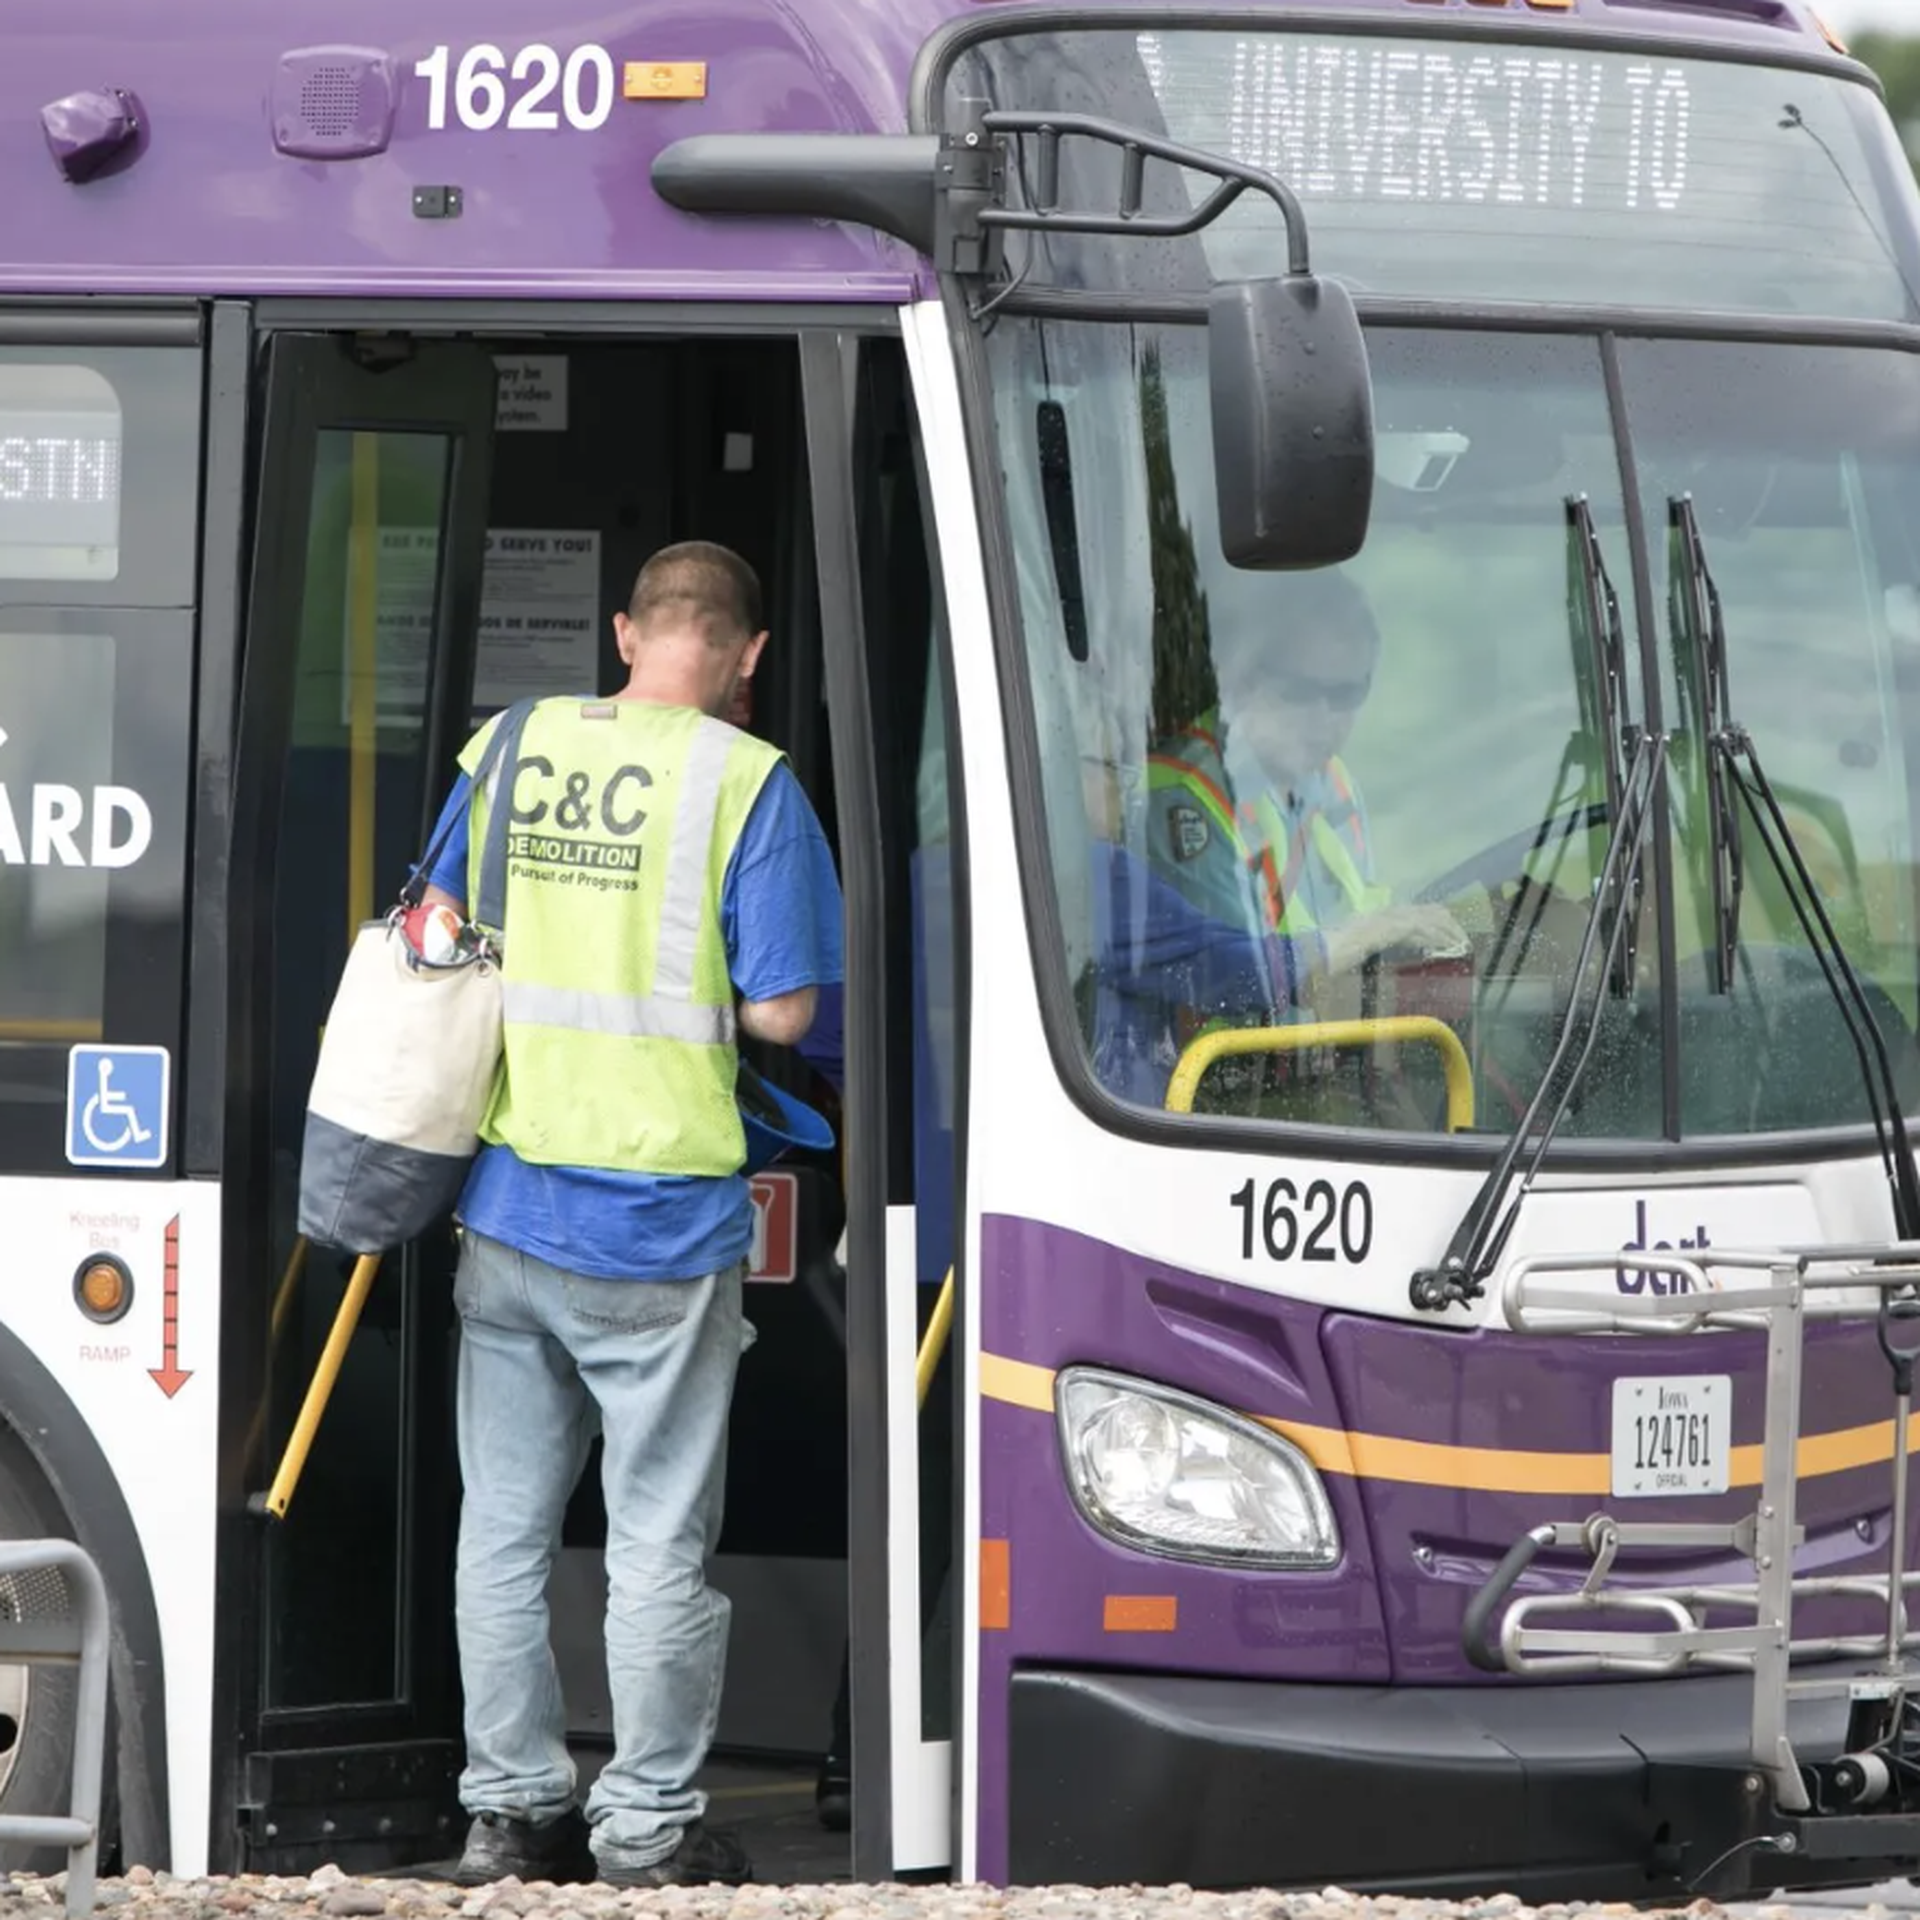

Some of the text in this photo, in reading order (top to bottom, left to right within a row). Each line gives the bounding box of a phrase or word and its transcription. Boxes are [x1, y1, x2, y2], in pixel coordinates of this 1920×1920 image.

[415, 43, 614, 130] 1620
[1231, 42, 1602, 204] UNIVERSITY
[1625, 66, 1690, 209] TO
[0, 438, 106, 500] STN
[501, 537, 546, 552] SERVE
[553, 538, 592, 553] YOU!
[511, 755, 654, 837] C&C
[511, 863, 639, 892] Pursuit of Progress
[69, 1211, 140, 1233] Kneeling
[1229, 1177, 1374, 1265] 1620
[79, 1345, 131, 1362] RAMP
[1635, 1413, 1711, 1468] 124761
